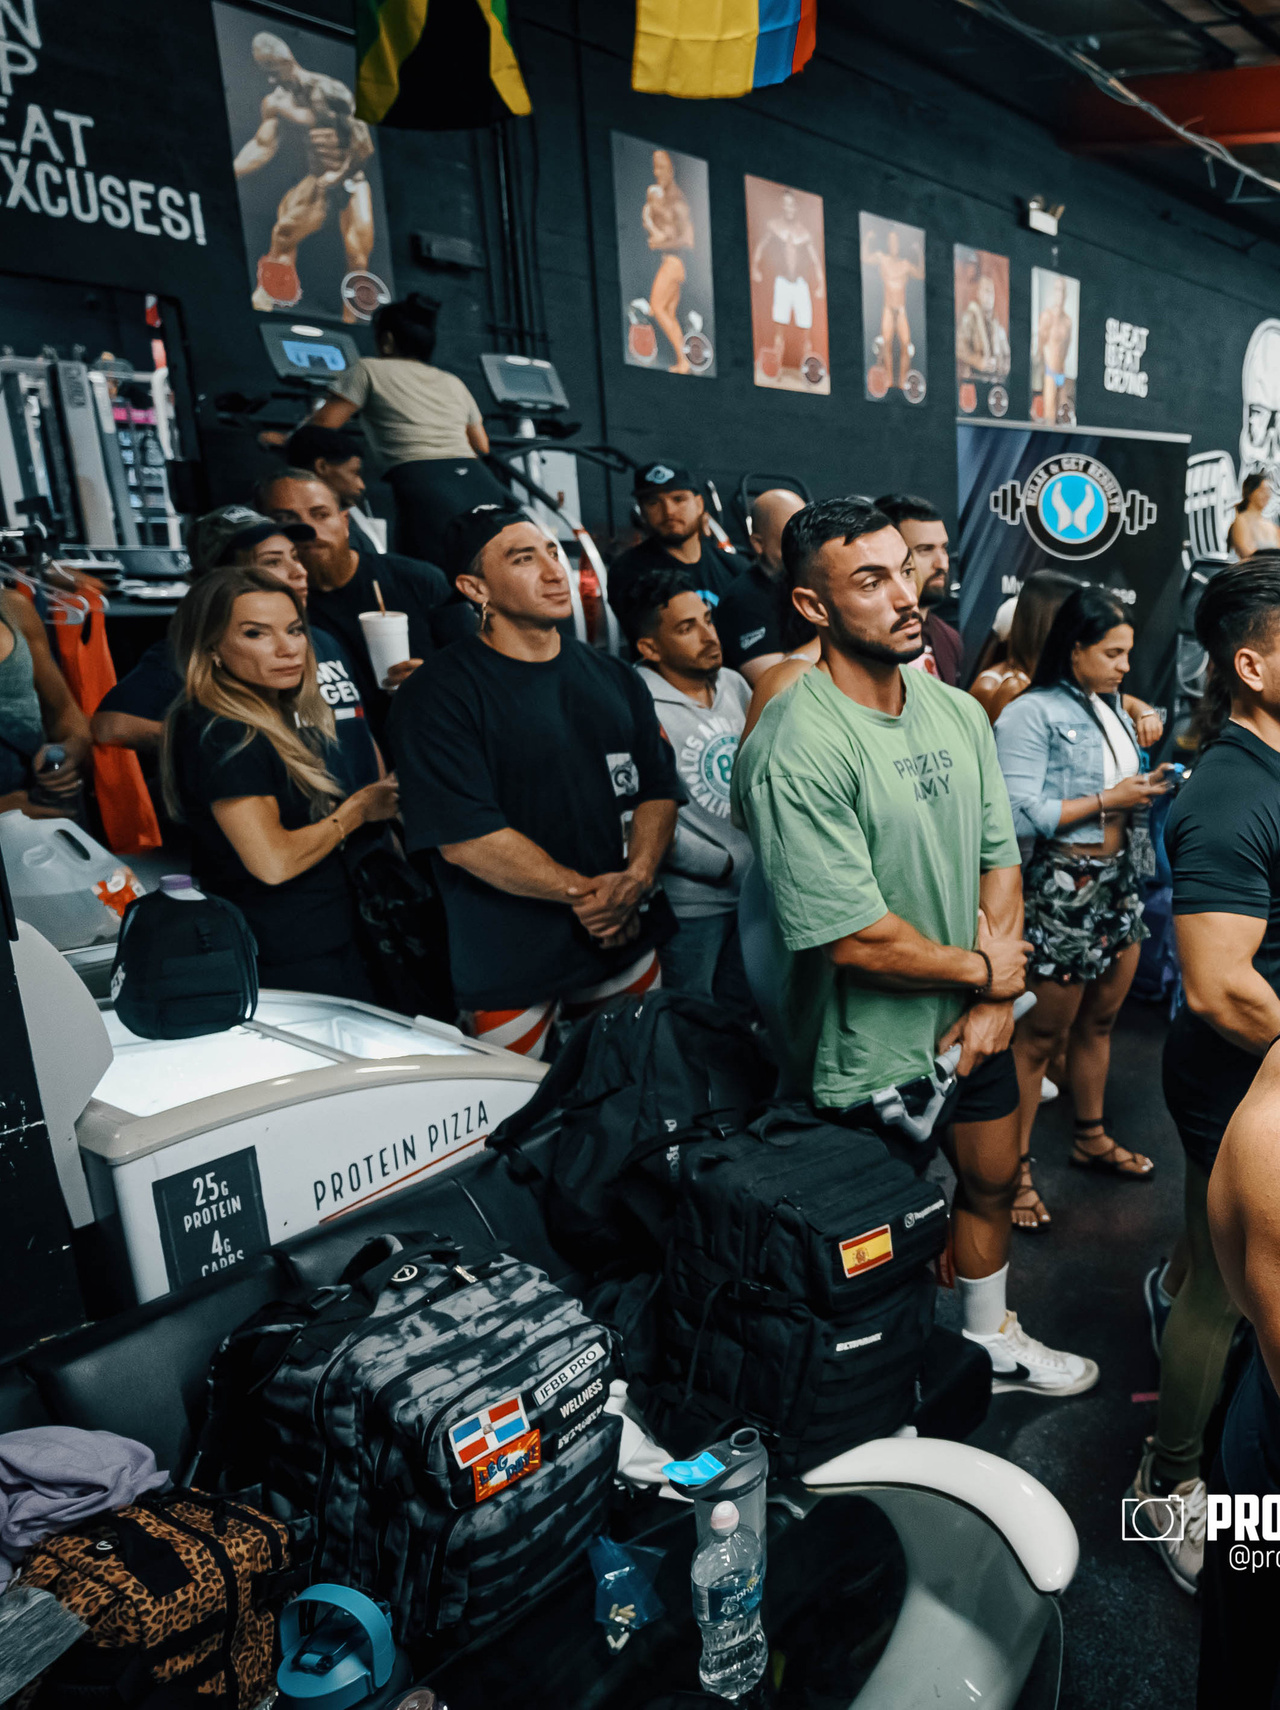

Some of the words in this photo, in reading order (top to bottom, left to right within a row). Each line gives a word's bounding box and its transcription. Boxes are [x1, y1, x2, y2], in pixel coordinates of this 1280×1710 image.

[312, 1133, 418, 1212] PROTEIN
[427, 1099, 490, 1153] PIZZA
[191, 1170, 230, 1207] 25G
[182, 1194, 243, 1234] PROTEIN
[210, 1228, 233, 1257] 4G
[538, 1371, 570, 1400] IFBB
[568, 1350, 598, 1376] PRO
[559, 1377, 605, 1419] WELLNESS
[478, 1454, 509, 1486] LEG
